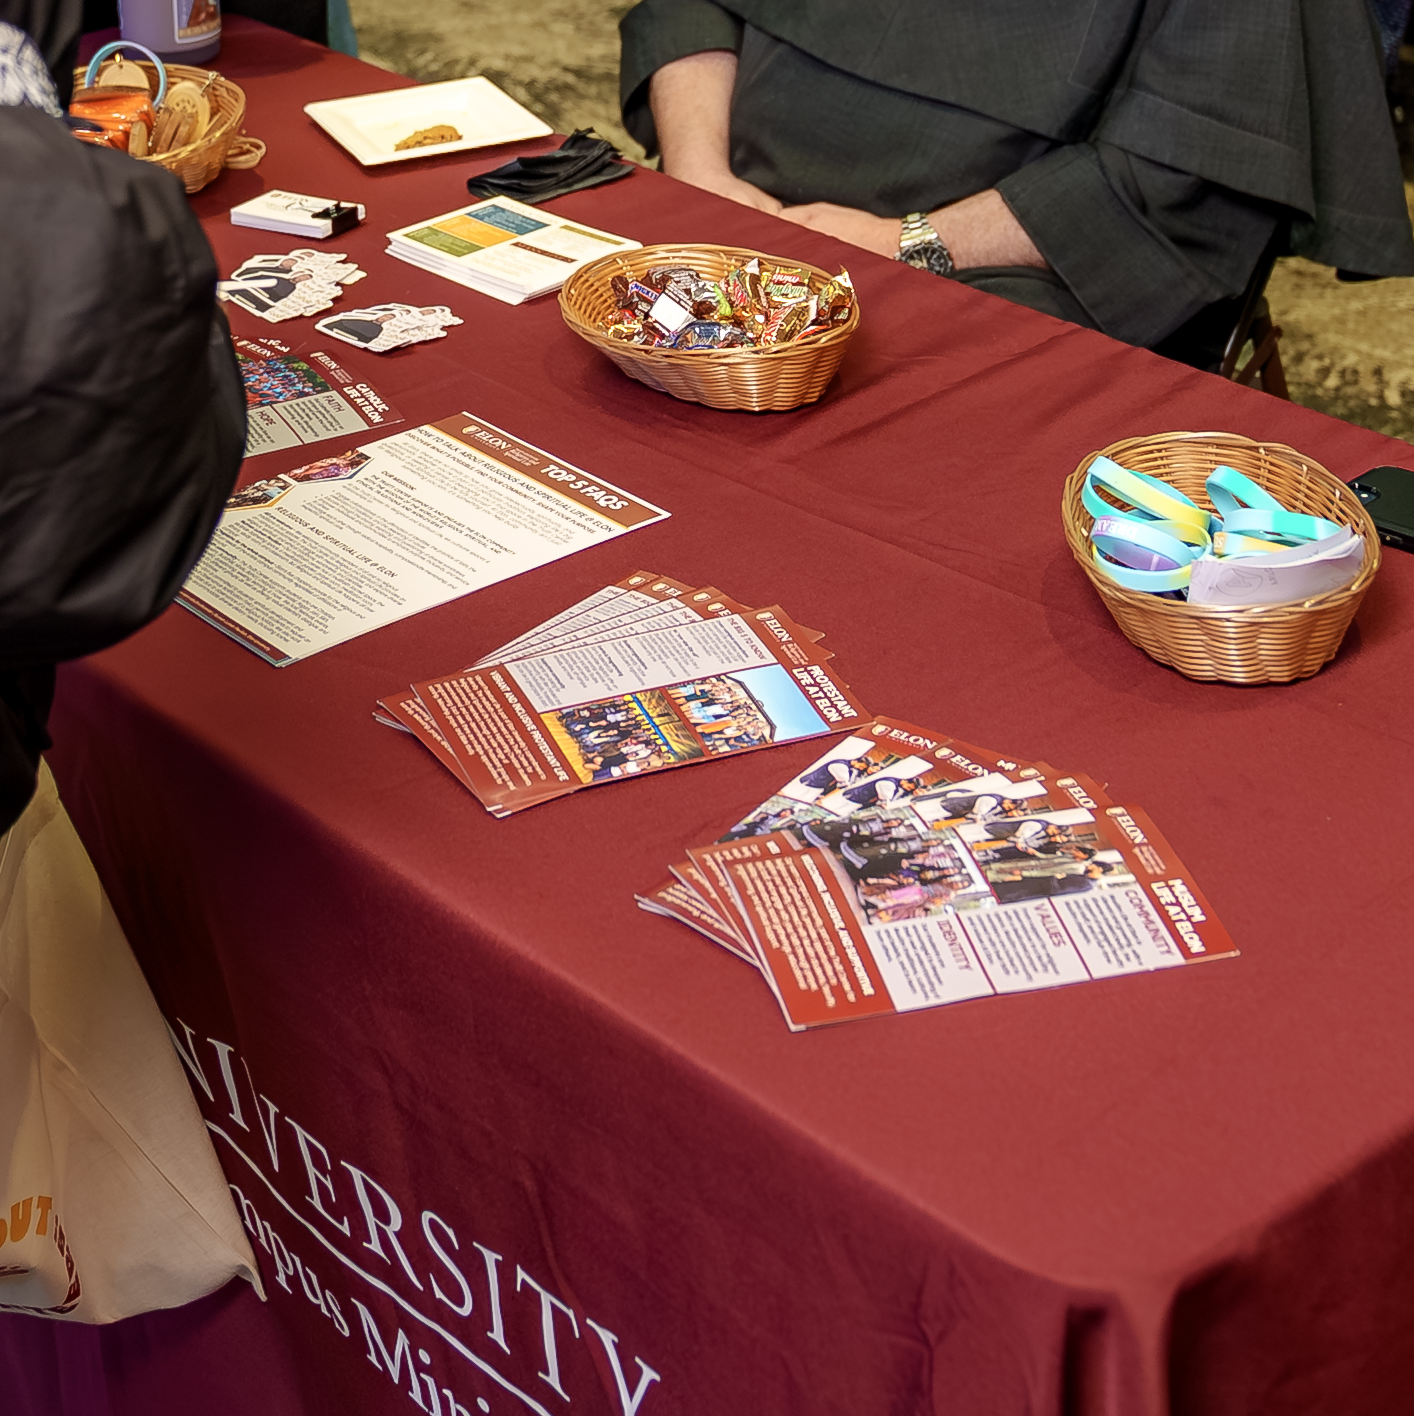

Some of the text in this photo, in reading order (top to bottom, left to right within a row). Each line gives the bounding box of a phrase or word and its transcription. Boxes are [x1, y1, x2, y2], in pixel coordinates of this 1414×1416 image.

[317, 355, 340, 370] ELON
[322, 395, 344, 413] FAITH
[343, 386, 384, 423] LIFE AT ELON
[356, 383, 389, 412] CATHOLIC
[474, 430, 512, 449] ELON
[540, 464, 628, 510] TOP 5 FAQS
[765, 619, 792, 642] ELON
[792, 667, 842, 722] LIFE AT ELON
[807, 665, 857, 717] PROTESTANT
[489, 670, 569, 782] VIBRANT AND INCLUSIVE PROTESTANT LIFE
[888, 728, 937, 751] ELON
[950, 754, 988, 777] ELON
[1068, 786, 1098, 810] ELO
[1116, 815, 1147, 844] ELON
[1151, 881, 1205, 953] LIFE AT ELON
[1168, 879, 1206, 922] MUSLIM
[1033, 902, 1067, 949] VALUES
[1125, 888, 1176, 957] COMMUNITY
[937, 919, 973, 972] IDENTITY
[167, 1017, 661, 1416] NIVERSITY
[229, 1183, 350, 1337] mpus
